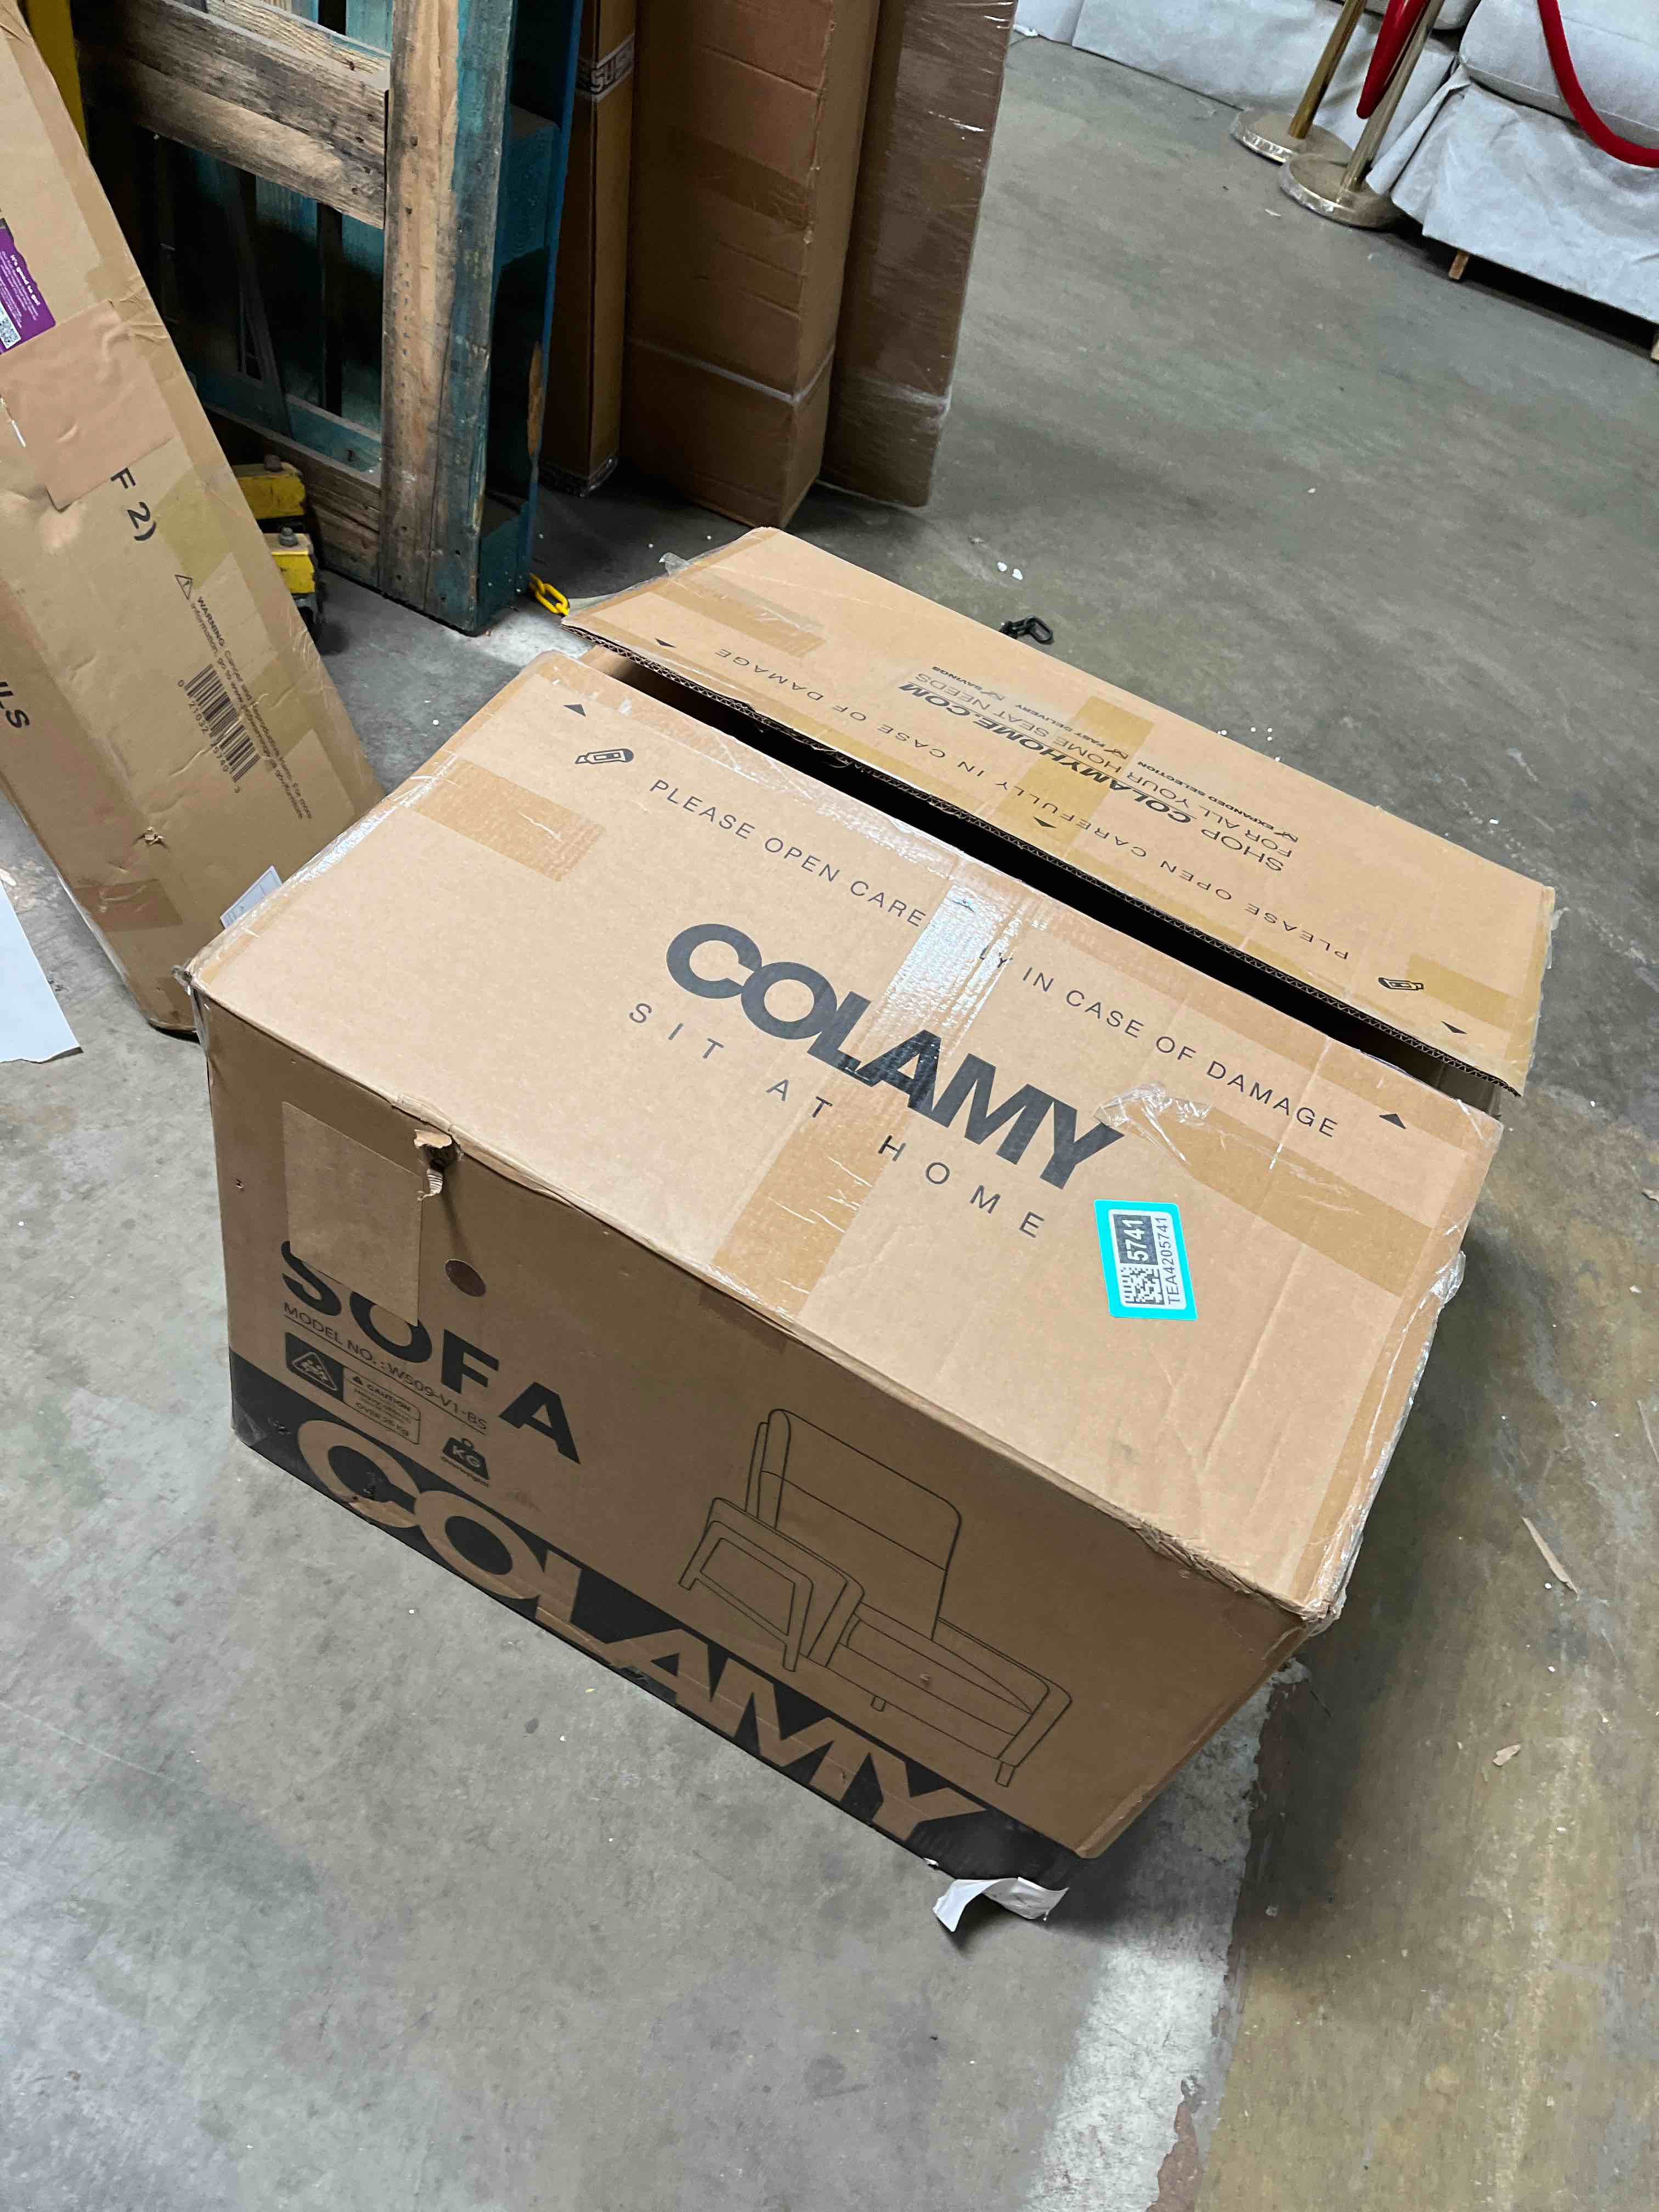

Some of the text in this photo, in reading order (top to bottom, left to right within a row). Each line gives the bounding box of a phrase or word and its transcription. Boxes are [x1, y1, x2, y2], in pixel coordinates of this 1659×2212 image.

[127, 501, 156, 541] 2)
[932, 665, 983, 691] SAVINGS
[1015, 704, 1105, 747] FAST DELIVERY
[715, 648, 1348, 960] PLEASE OPEN CAREFULLY IN CASE OF DAMAGE
[898, 684, 1283, 871] SHOP COLAMYHOME.COM
[915, 673, 1291, 857] FOR ALL YOUR HOME SEAT NEEDS
[1137, 761, 1274, 830] EXPANDED SELECTION
[300, 798, 312, 819] more
[650, 779, 755, 839] PLEASE
[765, 837, 840, 882] OPEN
[1022, 967, 1054, 992] IN
[1066, 990, 1144, 1038] CASE
[1156, 1036, 1196, 1060] OF
[1206, 1061, 1338, 1137] DAMAGE
[666, 923, 1125, 1190] COLAMY
[629, 1003, 1045, 1239] SIT AT HOME
[1122, 1219, 1149, 1261] 5741
[1155, 1218, 1180, 1305] TEA4205741
[284, 1302, 342, 1344] MODEL
[452, 1445, 481, 1468] KG
[296, 1420, 987, 1841] COLAMY
